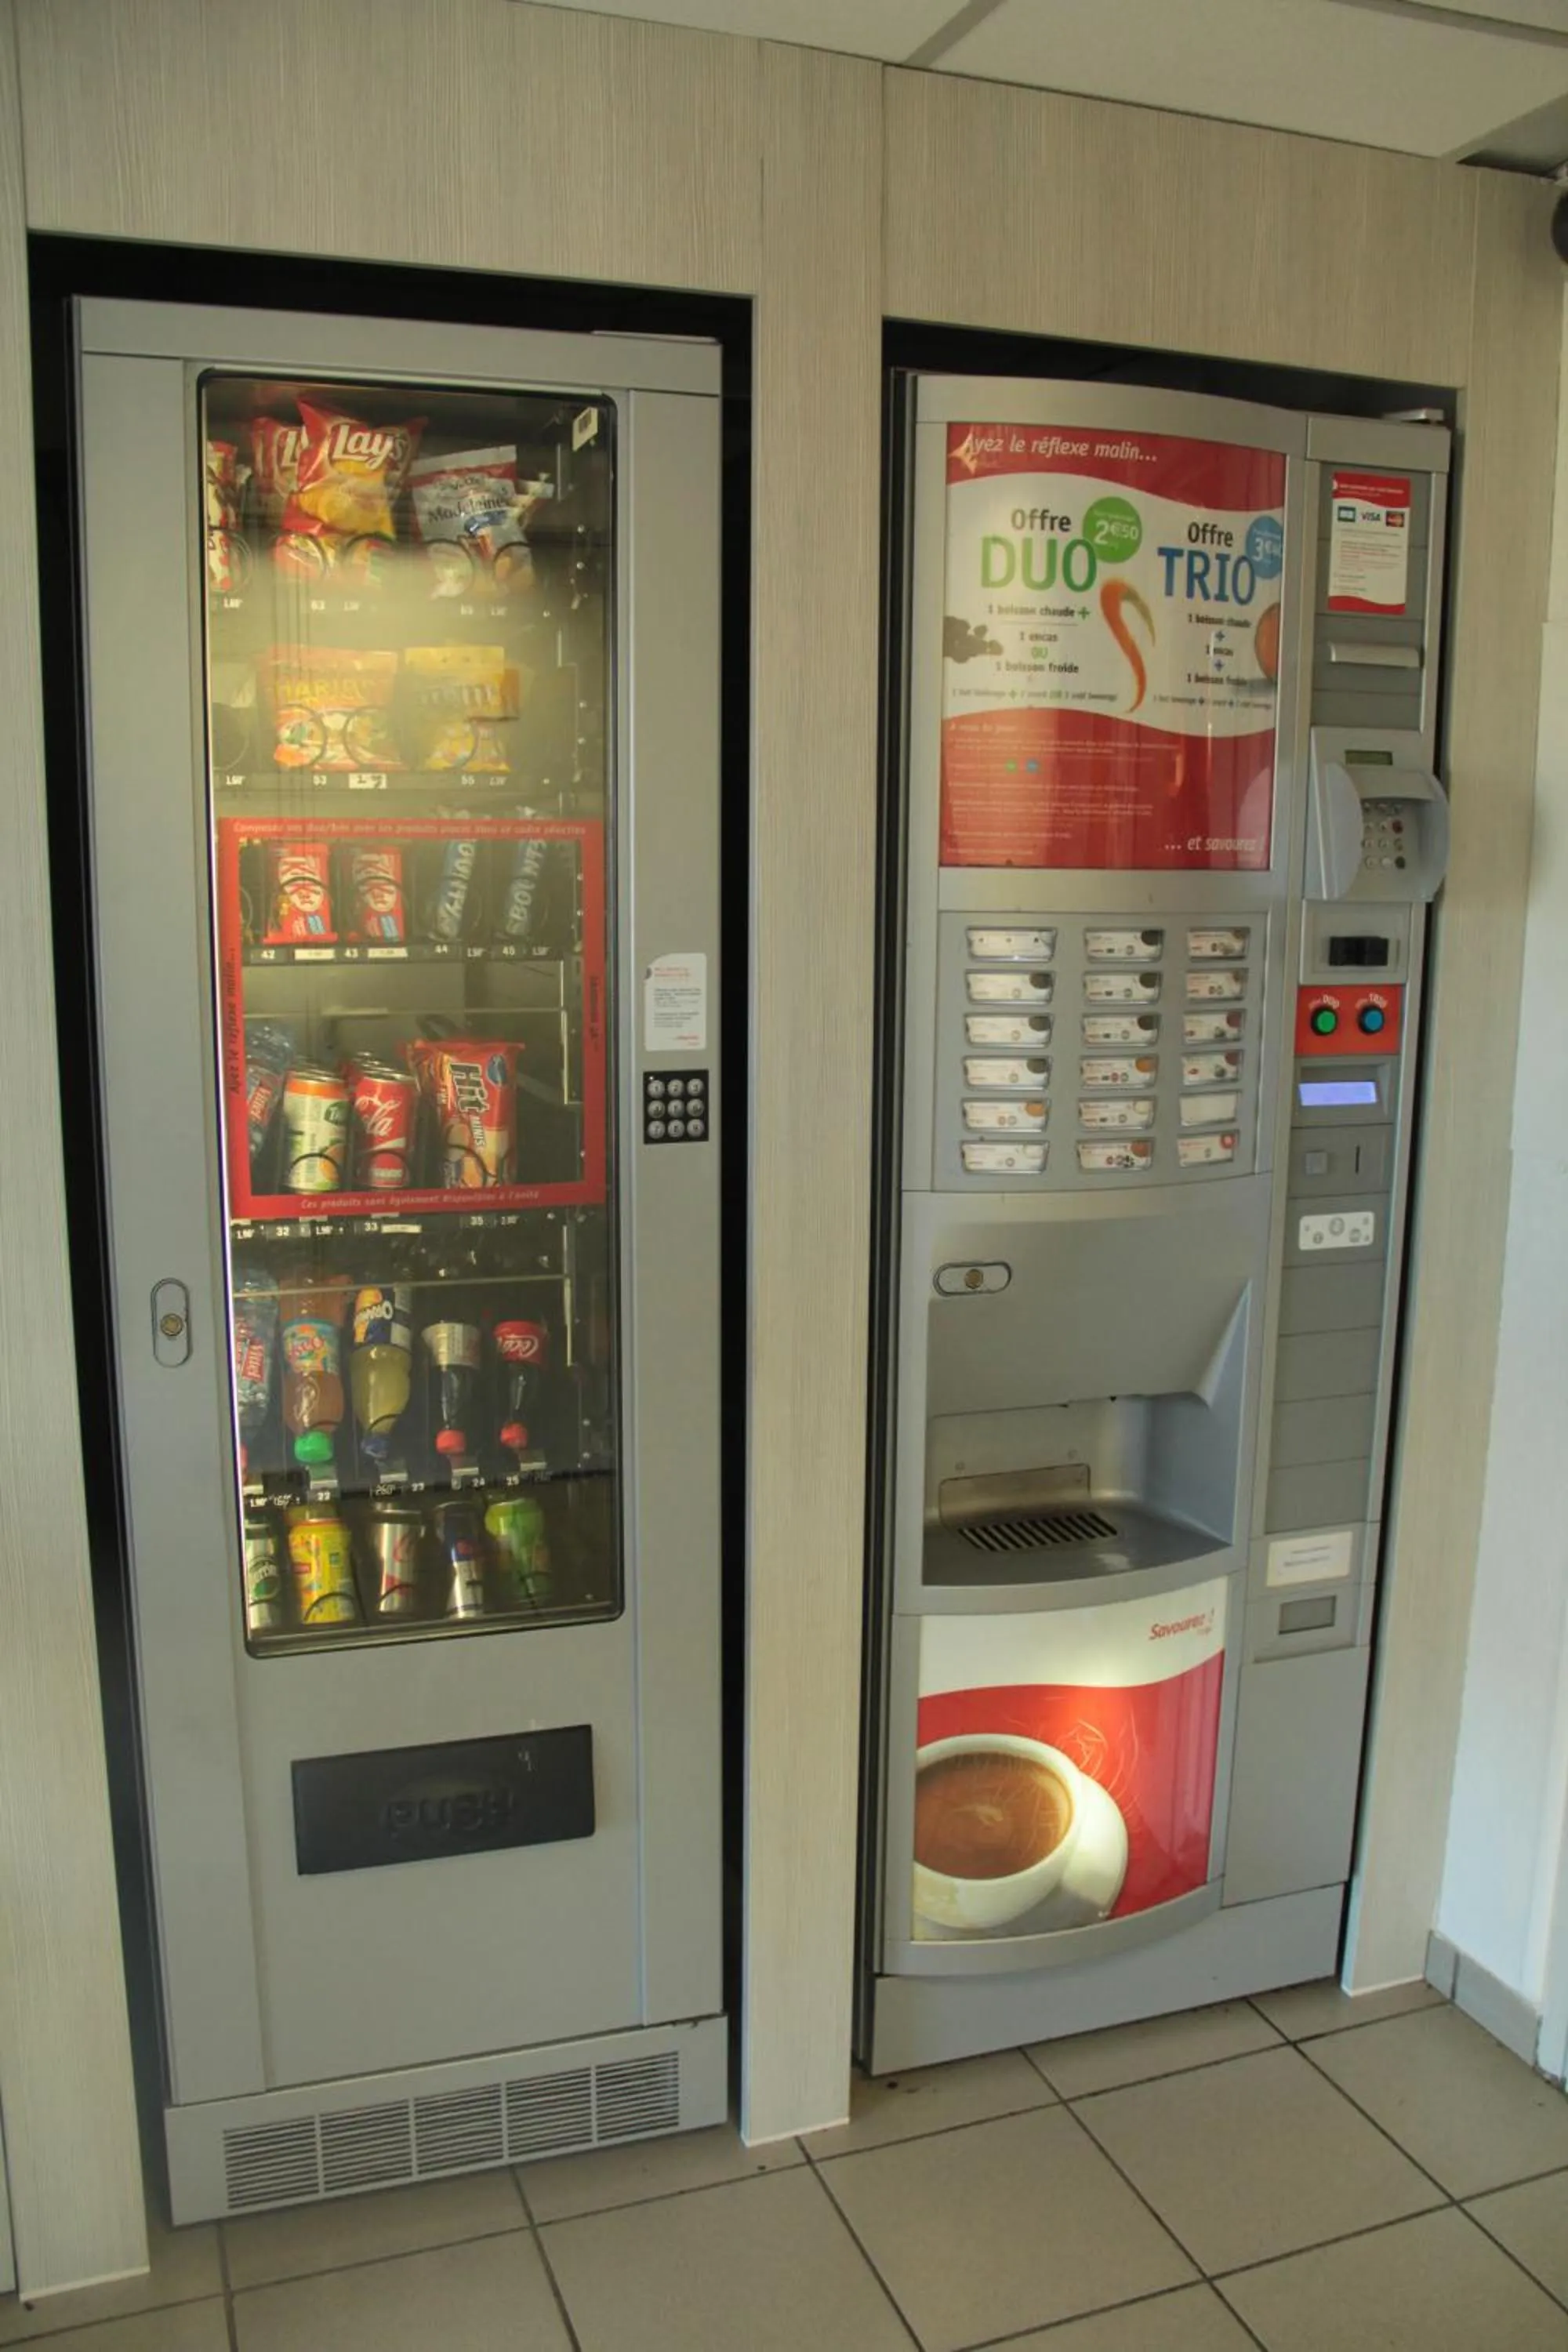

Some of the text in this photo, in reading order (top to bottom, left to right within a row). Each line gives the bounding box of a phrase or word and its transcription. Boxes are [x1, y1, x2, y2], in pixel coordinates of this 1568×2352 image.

[1010, 437, 1025, 452] le
[1032, 437, 1089, 456] réflexe
[1011, 508, 1073, 532] Offre
[1188, 521, 1234, 547] Offre
[980, 535, 1097, 592] DUO
[1157, 546, 1255, 606] TRIO
[1039, 605, 1076, 618] chaude
[1048, 662, 1080, 674] froide
[1187, 835, 1202, 851] et
[449, 1062, 491, 1113] Hit
